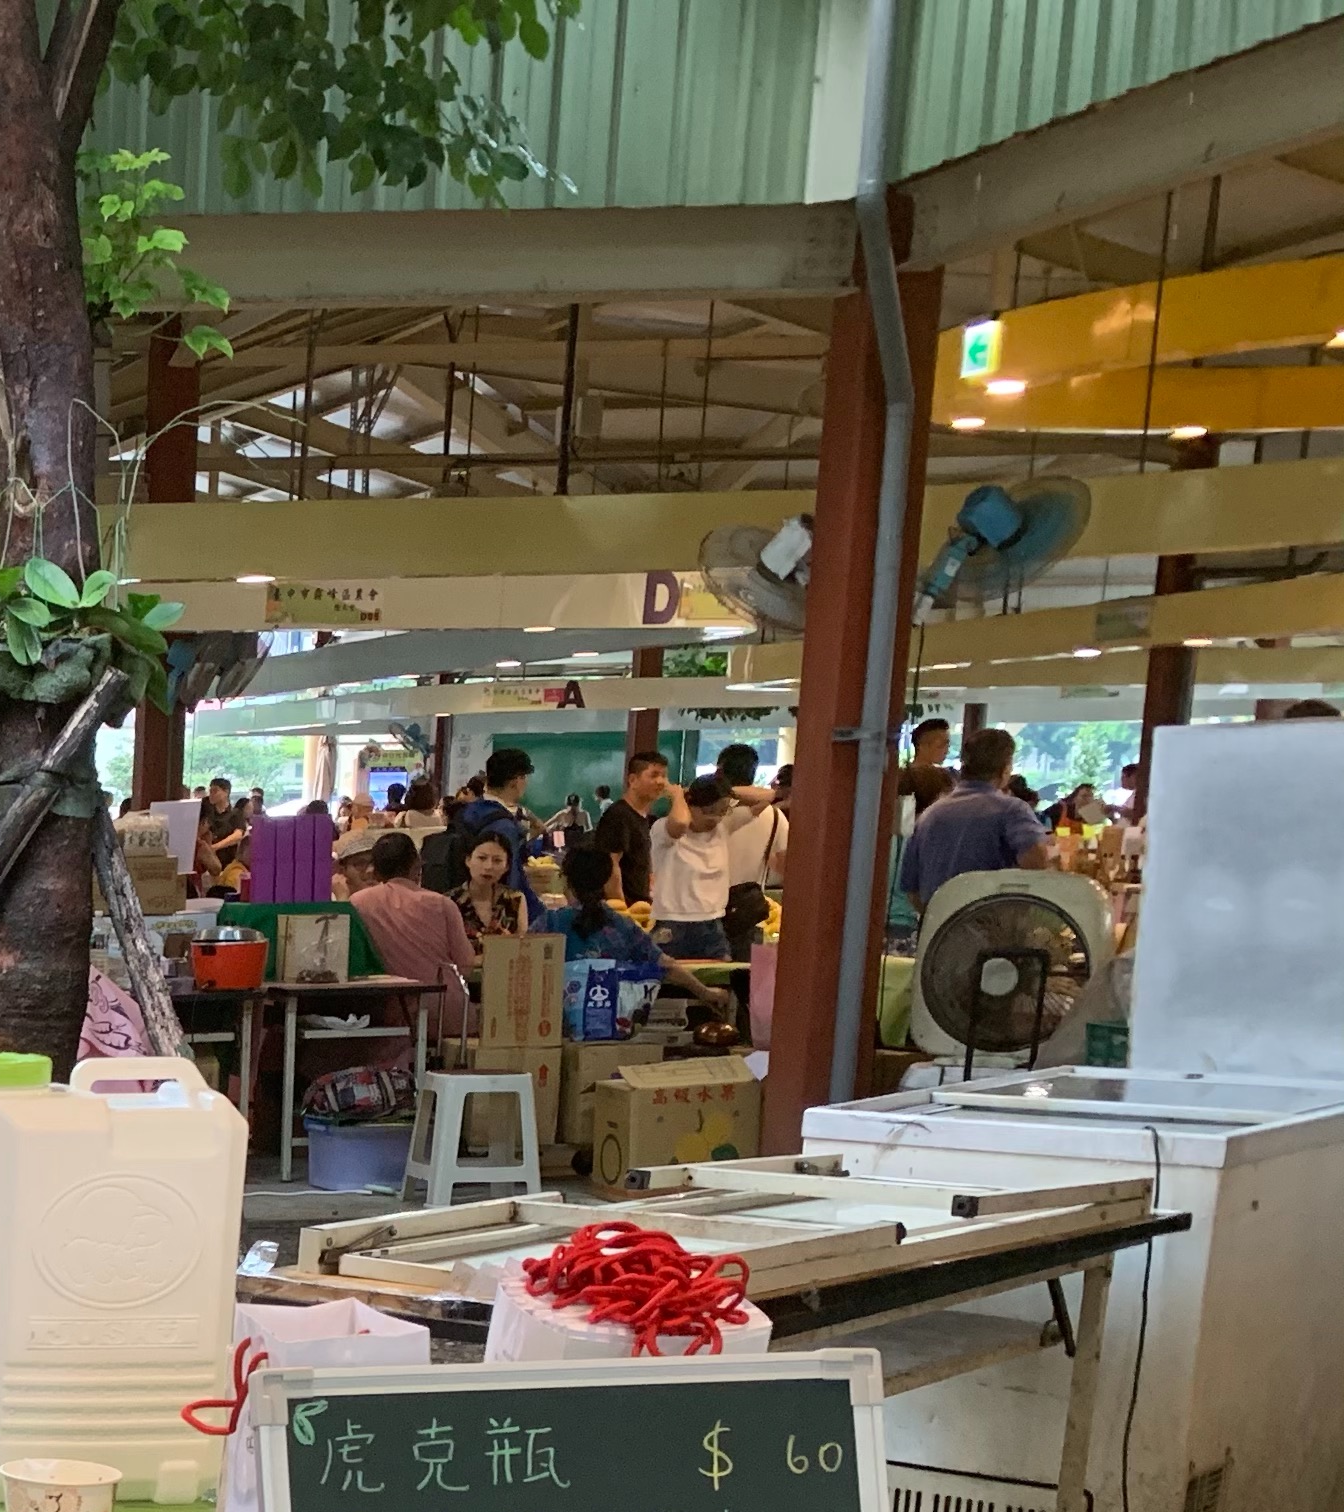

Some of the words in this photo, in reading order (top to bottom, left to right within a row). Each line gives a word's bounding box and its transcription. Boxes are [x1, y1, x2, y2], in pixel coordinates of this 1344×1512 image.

[643, 570, 681, 624] D
[556, 680, 586, 708] A
[320, 1417, 571, 1492] 虎克瓶
[698, 1420, 734, 1490] $
[785, 1433, 843, 1474] 60
